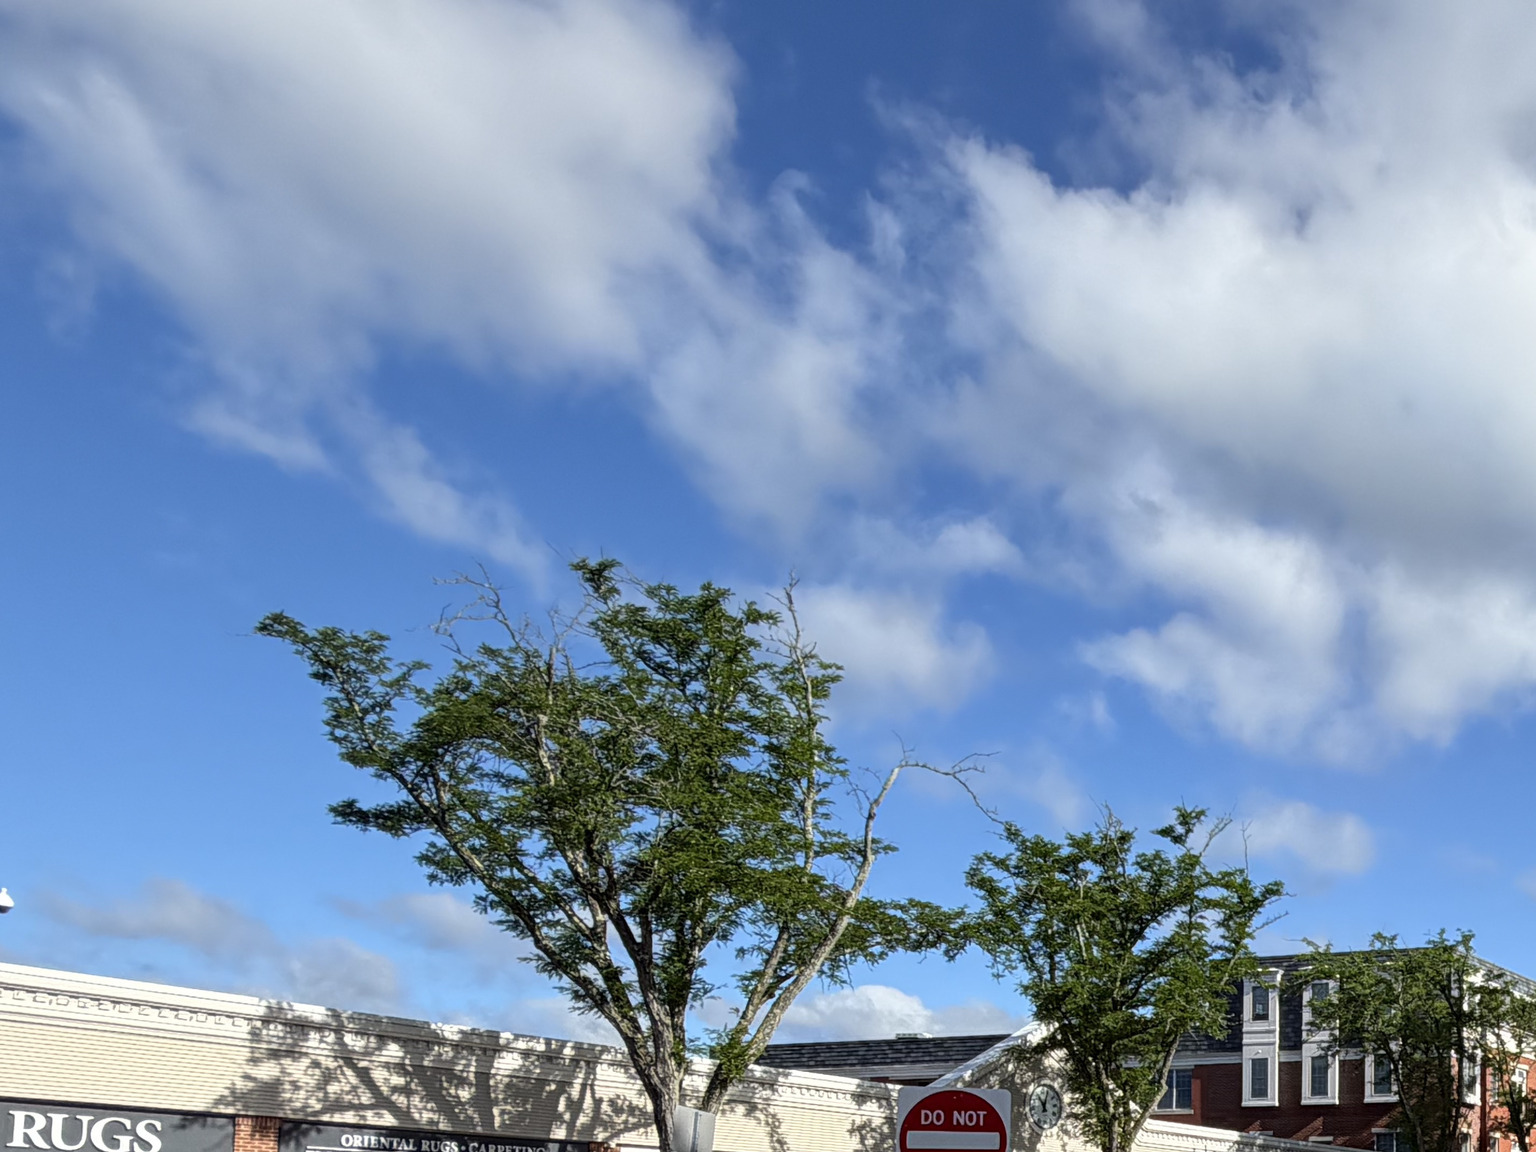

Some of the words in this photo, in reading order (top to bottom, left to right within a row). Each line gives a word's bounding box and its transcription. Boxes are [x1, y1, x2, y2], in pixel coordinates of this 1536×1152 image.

[920, 1109, 945, 1125] DO
[953, 1110, 987, 1127] NOT
[341, 1134, 417, 1151] ORIENTAL
[421, 1140, 458, 1152] RUGS
